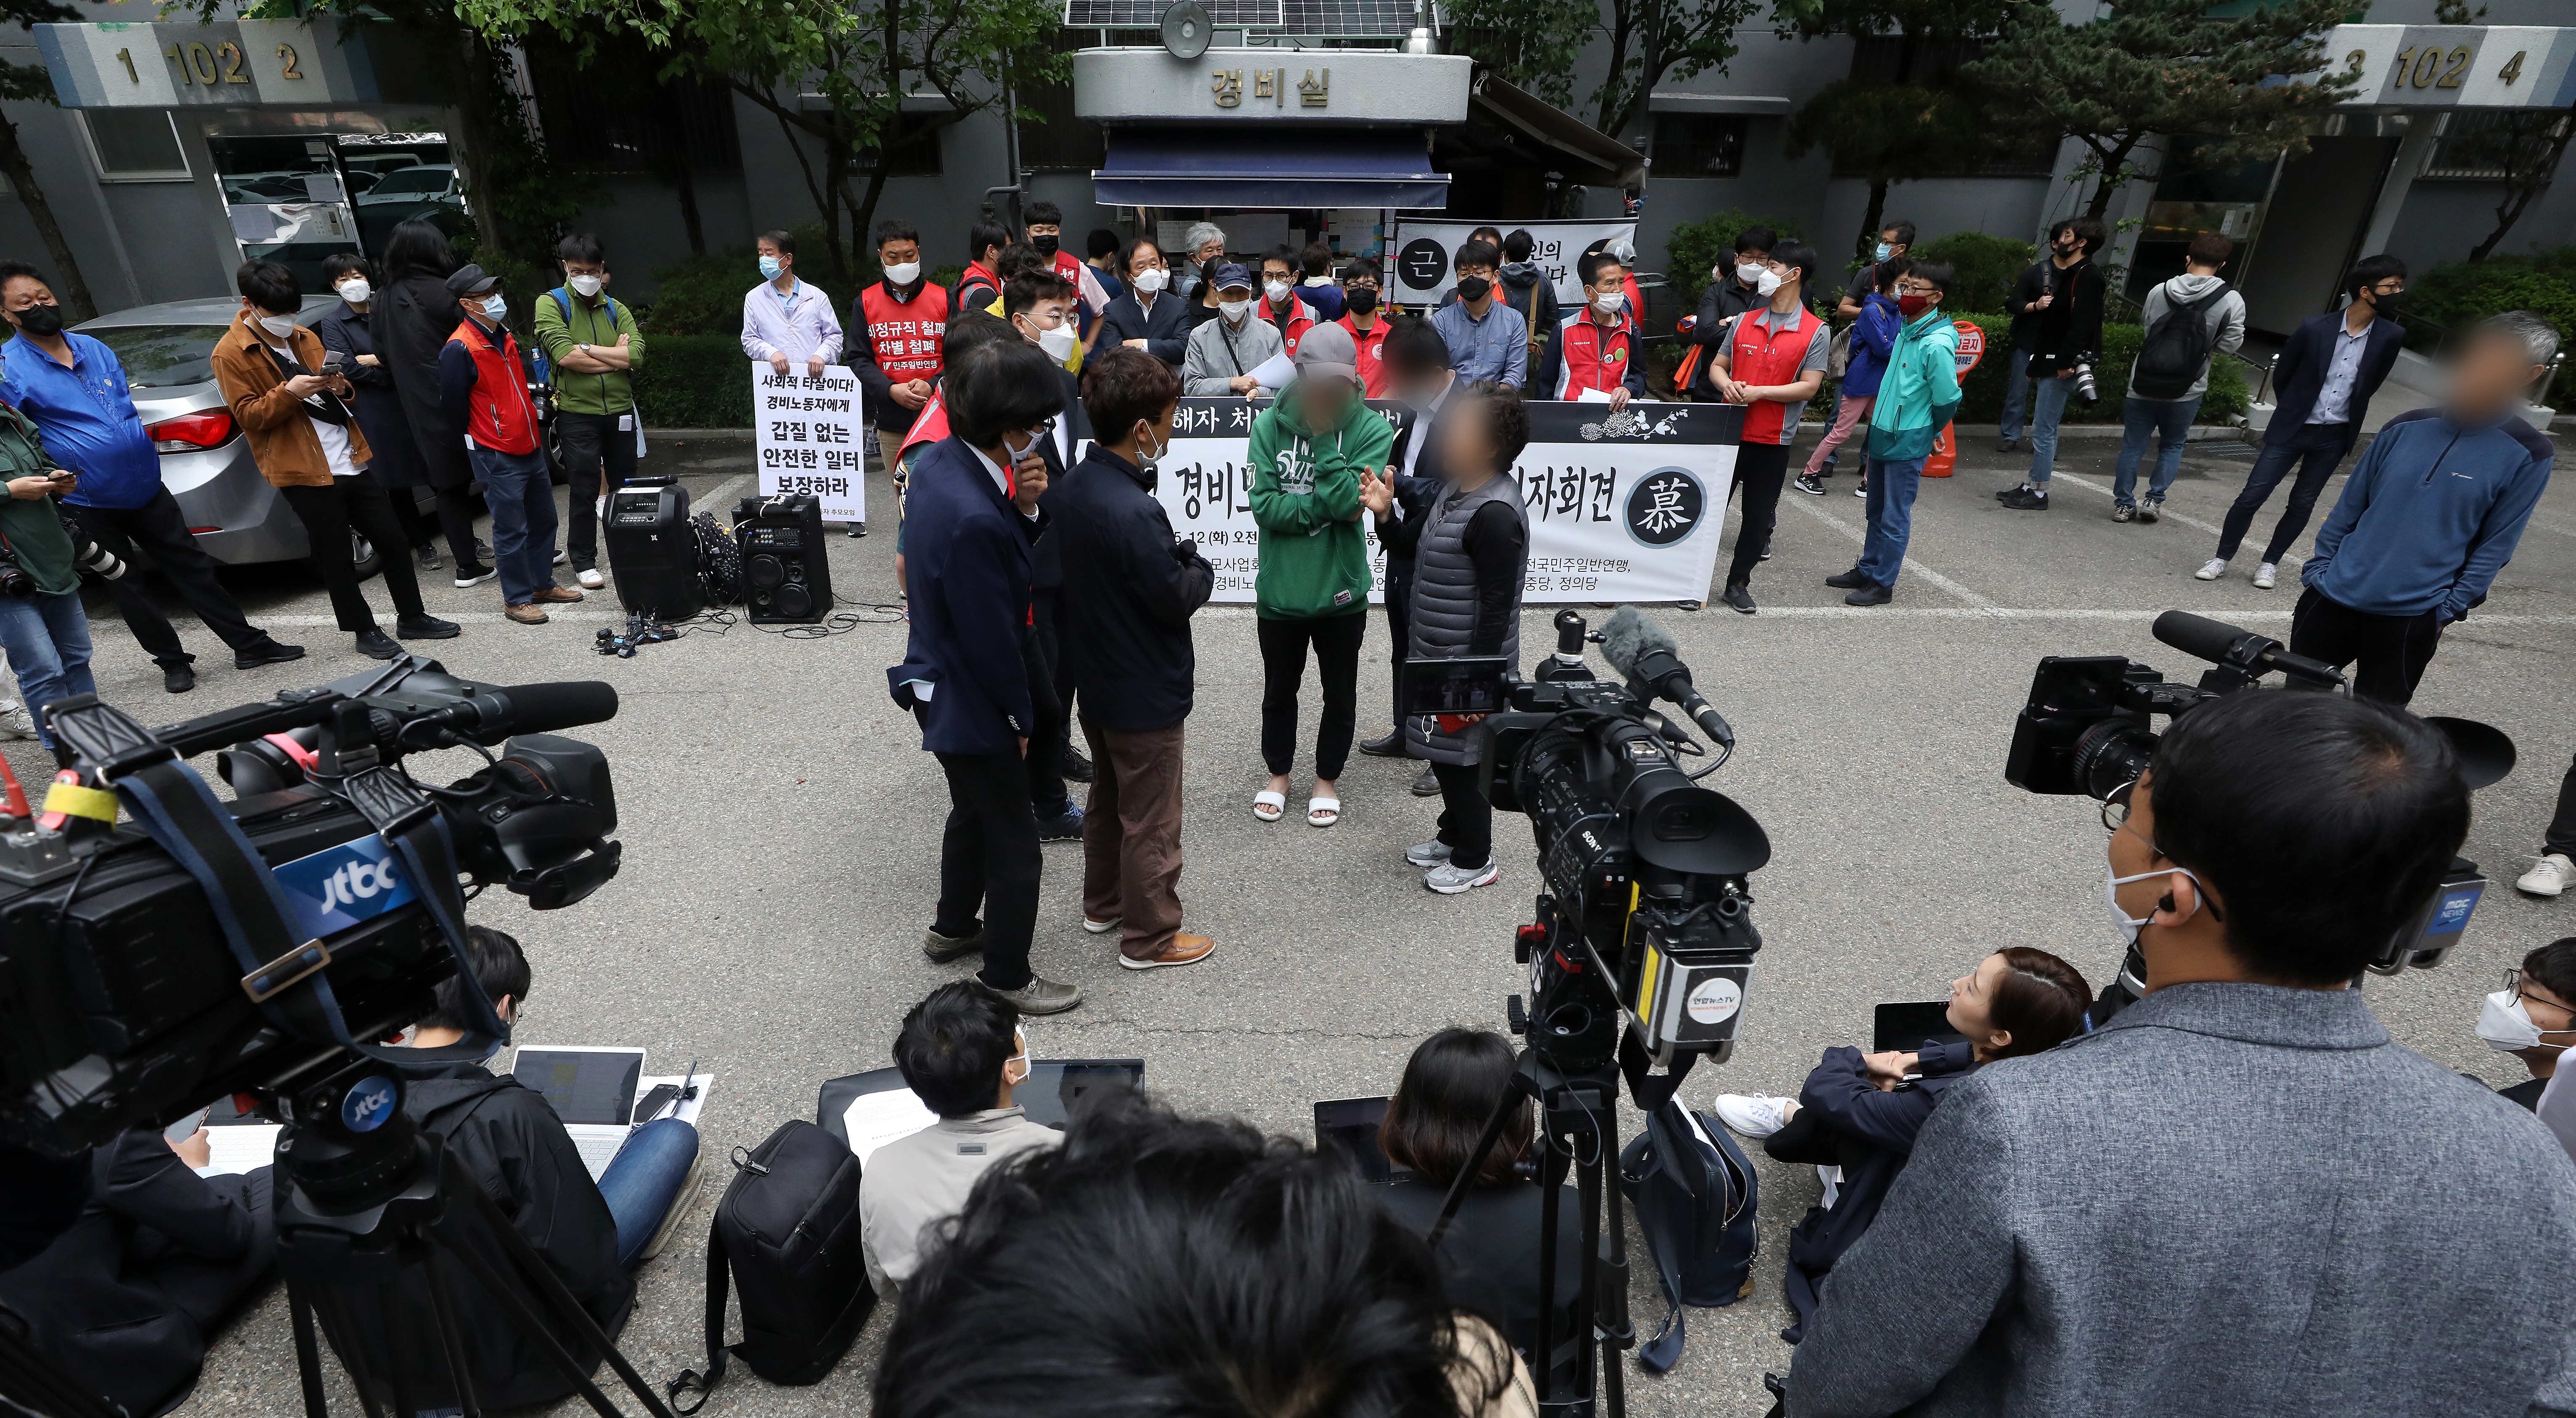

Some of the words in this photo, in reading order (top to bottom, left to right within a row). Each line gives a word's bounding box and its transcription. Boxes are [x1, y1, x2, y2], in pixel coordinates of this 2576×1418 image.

[116, 48, 139, 83] 1
[168, 41, 249, 85] 102
[276, 43, 302, 80] 2
[2396, 45, 2473, 88] 102
[2498, 50, 2527, 85] 4
[1212, 68, 1330, 107] 경비실
[1530, 240, 1561, 261] 인의
[1410, 250, 1437, 278] 근
[868, 321, 916, 338] 비정규직
[921, 321, 946, 337] 철폐
[879, 340, 904, 355] 차별
[909, 340, 935, 354] 철폐
[893, 360, 937, 370] 민주일반연맹
[761, 374, 798, 390] 사회적
[802, 377, 854, 393] 타살이다!
[766, 396, 850, 413] 경비노동자에게
[1172, 406, 1220, 434] 해자
[1230, 406, 1271, 433] 처
[771, 421, 808, 442] 갑질
[814, 422, 850, 443] 없는
[763, 448, 818, 469] 안전한
[826, 451, 859, 471] 일터
[1276, 449, 1317, 485] Sup
[777, 475, 849, 497] 보장하라
[1636, 477, 1692, 534] 慕
[1208, 531, 1229, 546] (화)
[1232, 531, 1257, 545] 오전
[1369, 559, 1386, 573] 동
[1526, 558, 1631, 574] 전국민주일반연맹,
[1213, 576, 1254, 591] 경비노
[1525, 576, 1553, 592] 중당,
[1559, 576, 1598, 591] 정의당
[1582, 831, 1602, 852] SONY
[2440, 908, 2465, 919] NEWS
